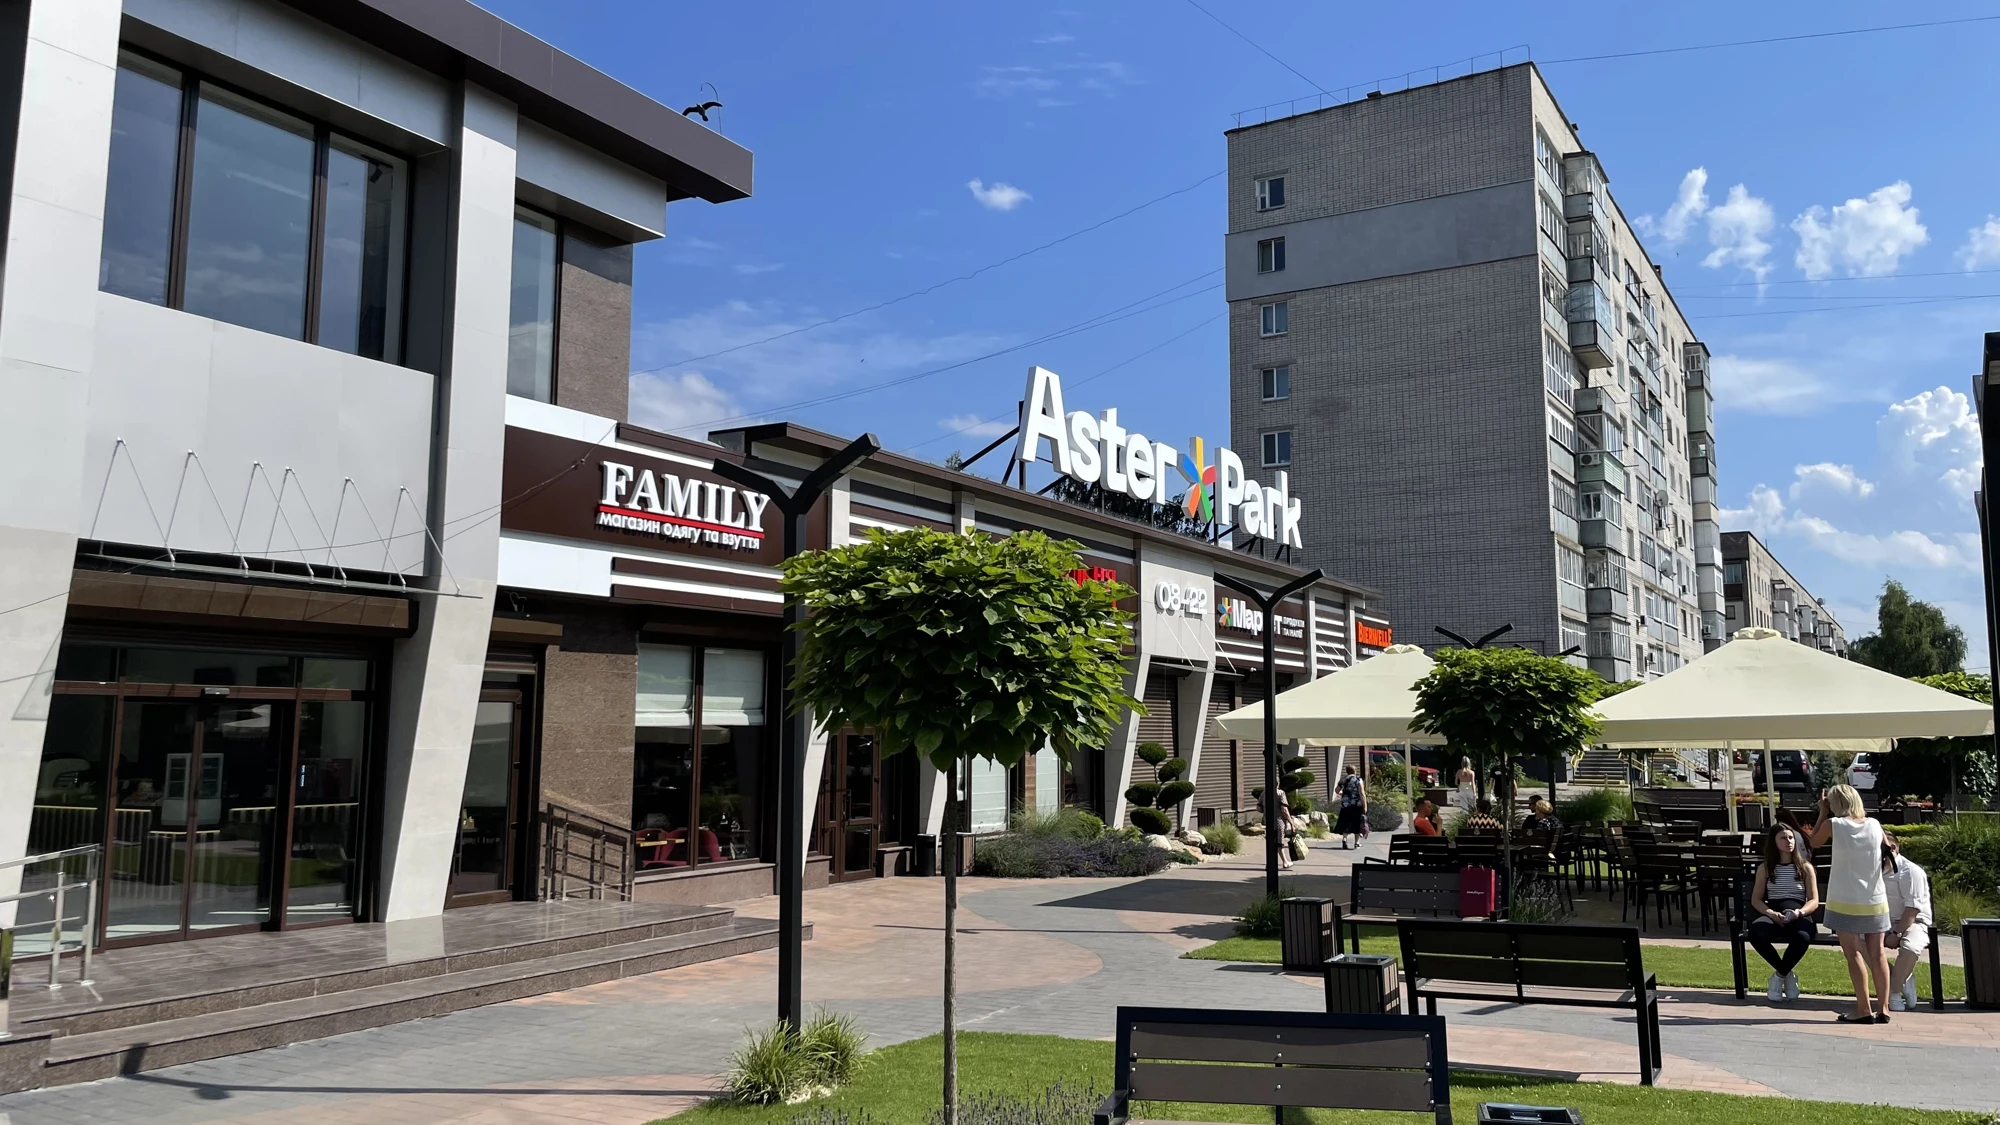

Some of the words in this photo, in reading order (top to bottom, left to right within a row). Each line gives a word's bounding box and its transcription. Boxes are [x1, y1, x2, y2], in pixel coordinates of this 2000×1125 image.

[1016, 366, 1178, 505] Aster
[1215, 447, 1303, 549] Park
[600, 461, 771, 532] FAMILY
[597, 512, 661, 534] магазин
[661, 523, 702, 543] одягу
[704, 530, 720, 543] та
[721, 532, 760, 550] взуття
[1231, 599, 1282, 636] Март
